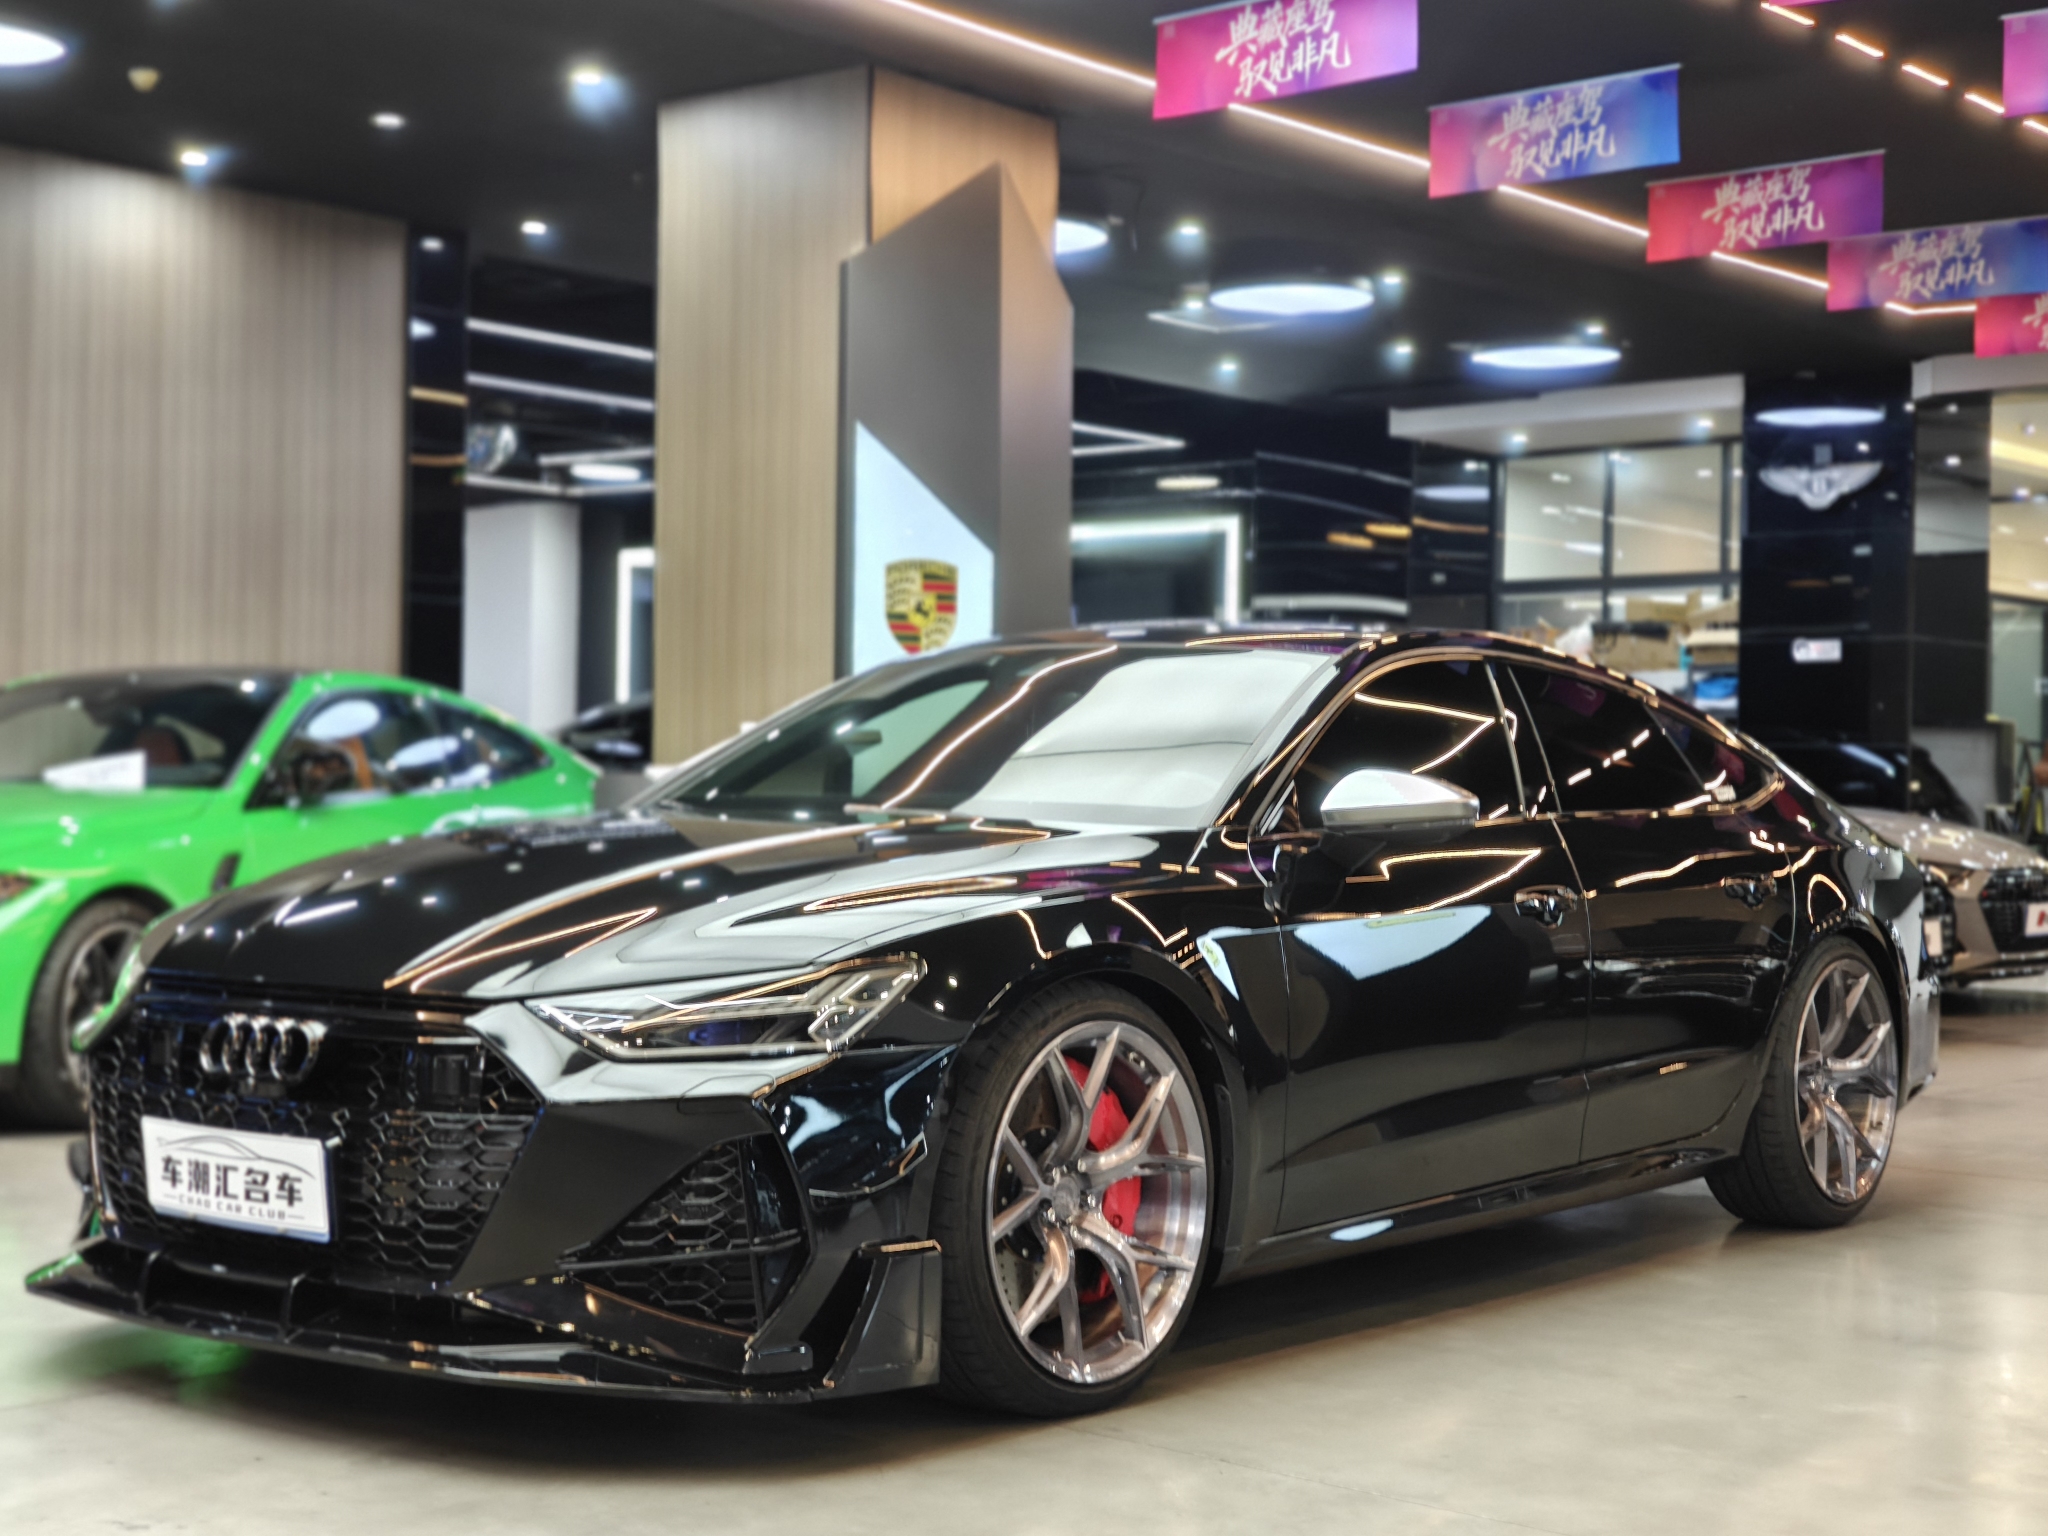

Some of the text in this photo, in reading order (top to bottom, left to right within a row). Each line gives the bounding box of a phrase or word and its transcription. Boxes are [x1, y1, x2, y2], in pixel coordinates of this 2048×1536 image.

[161, 1154, 304, 1208] 车潮汇名车
[216, 1201, 243, 1215] CAR
[249, 1205, 286, 1221] CLUB
